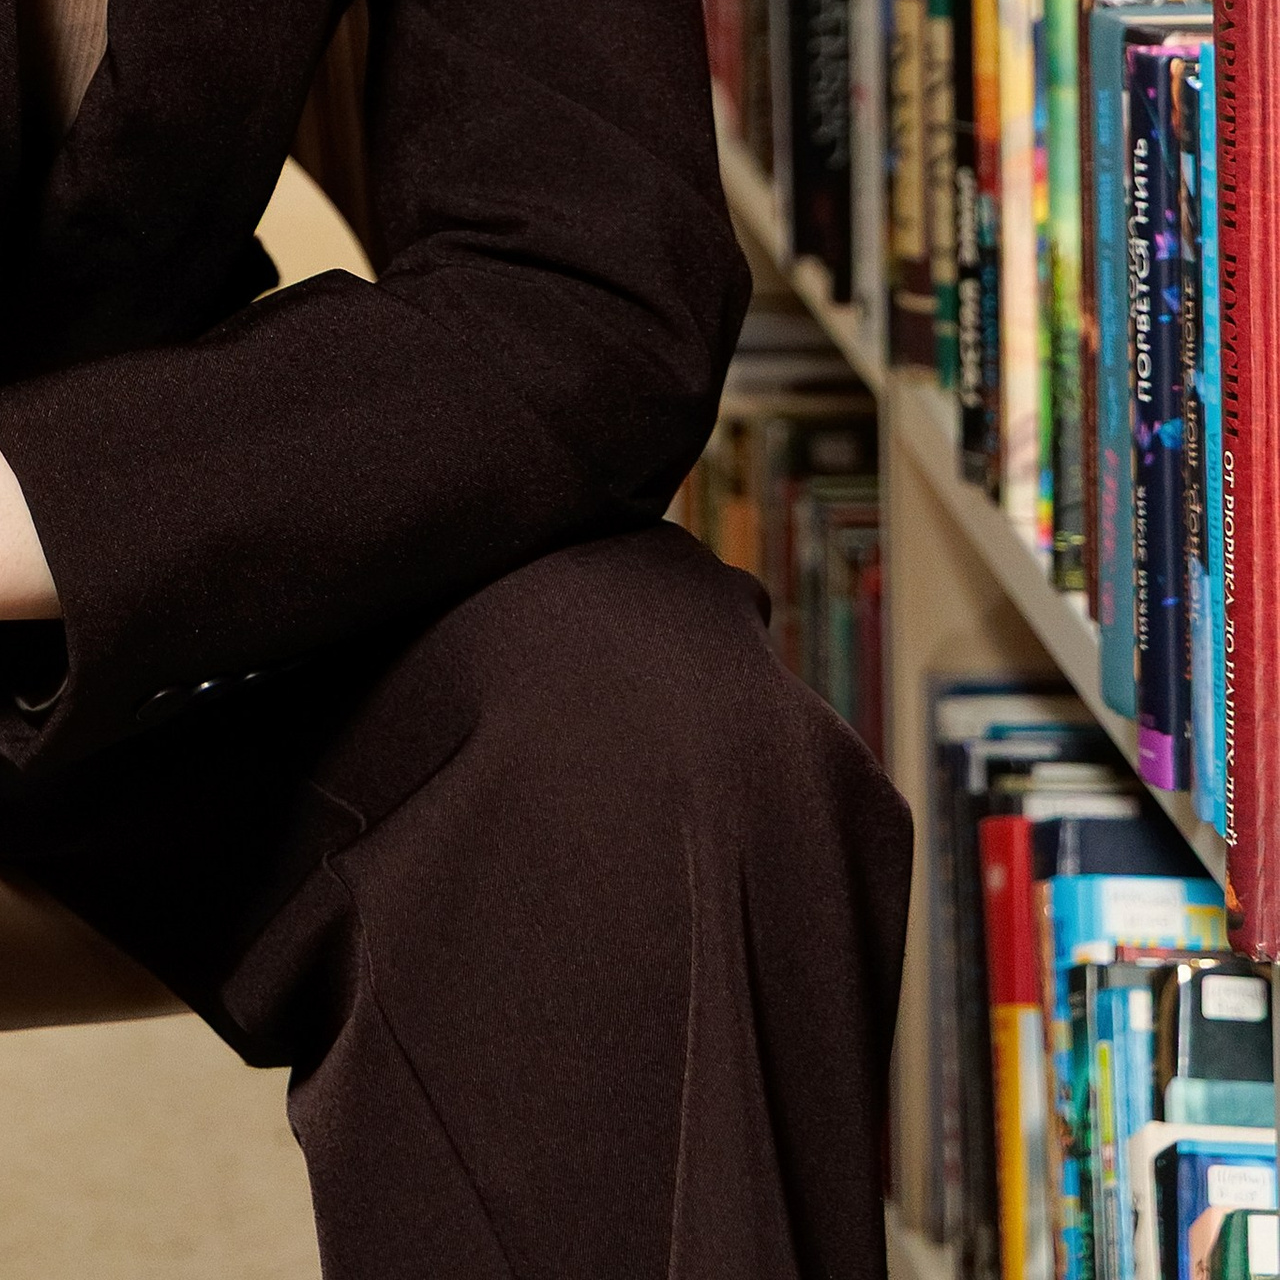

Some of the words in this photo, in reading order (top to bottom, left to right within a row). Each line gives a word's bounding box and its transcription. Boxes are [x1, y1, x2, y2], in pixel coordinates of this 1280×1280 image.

[1133, 138, 1150, 224] НИТЬ
[1222, 253, 1239, 440] РОССИИ
[1223, 450, 1234, 487] ОТ
[1224, 494, 1235, 605] РЮРИКА
[1225, 613, 1234, 653] ДО
